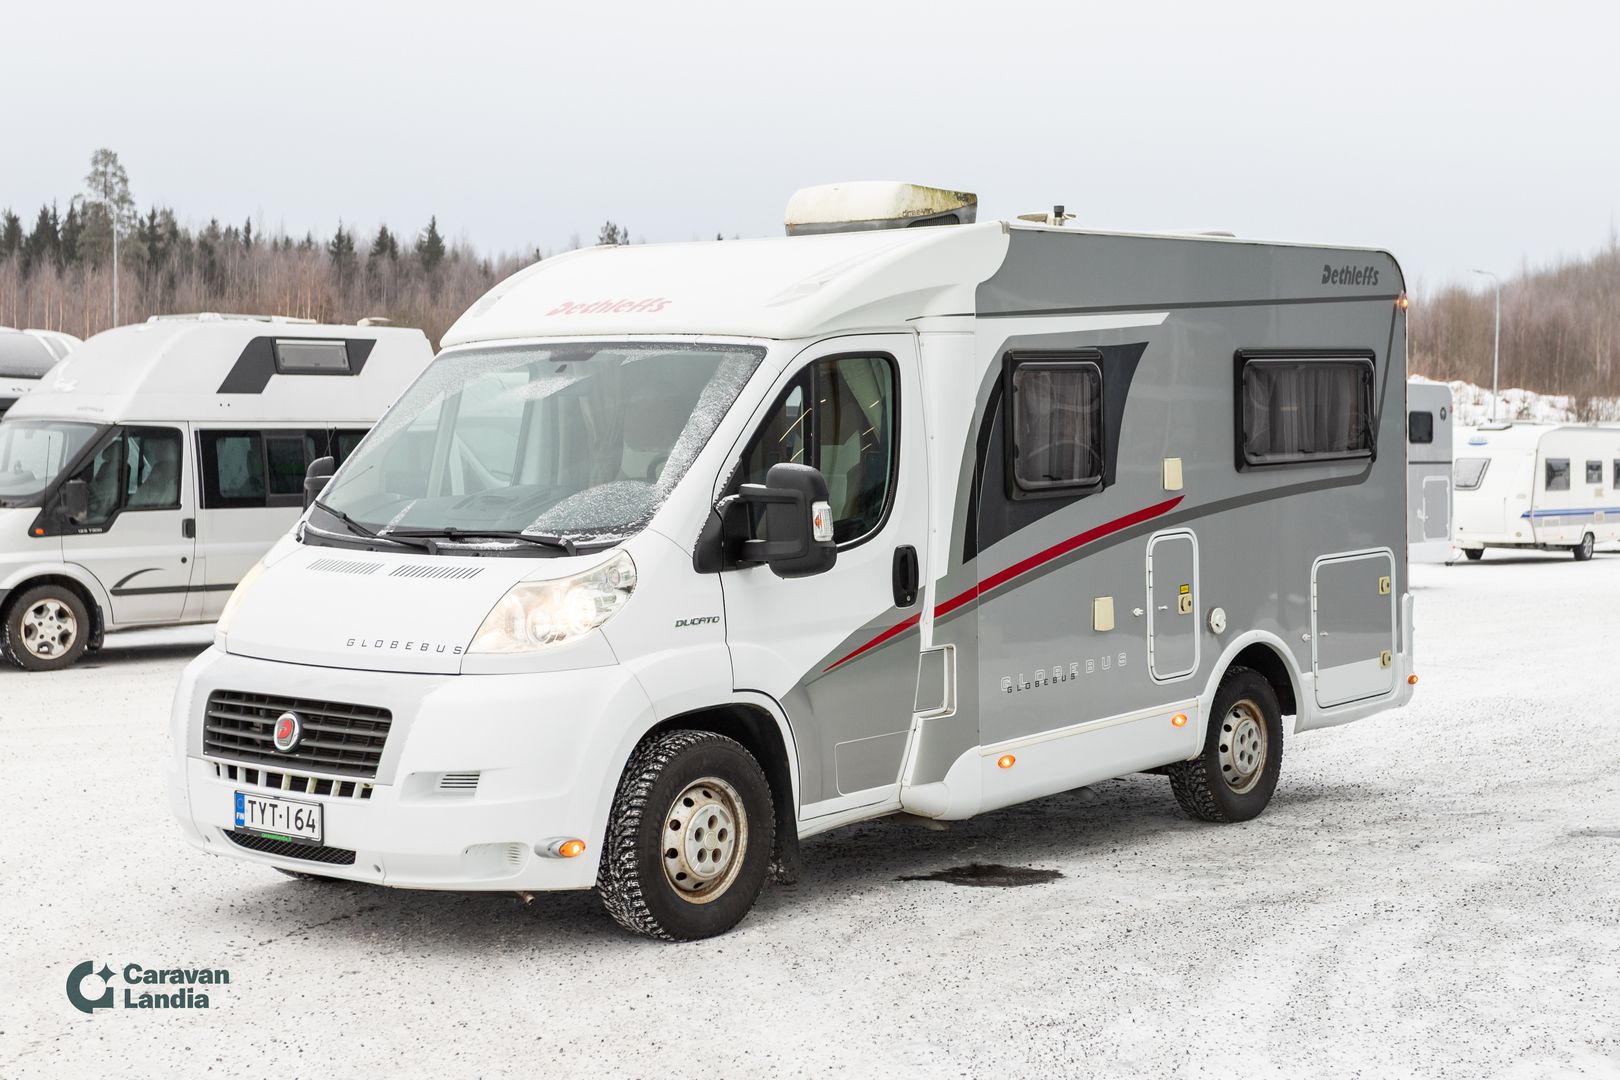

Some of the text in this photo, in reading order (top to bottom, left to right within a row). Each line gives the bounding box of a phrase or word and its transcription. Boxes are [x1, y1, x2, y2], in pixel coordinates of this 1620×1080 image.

[1321, 264, 1380, 286] Dethleffs
[543, 297, 673, 317] Dethleffs
[674, 615, 721, 628] DUCATO
[345, 638, 464, 656] GLOBEBUS
[1000, 651, 1127, 692] GLOBEBUS
[1006, 672, 1076, 694] GLOBEBUS
